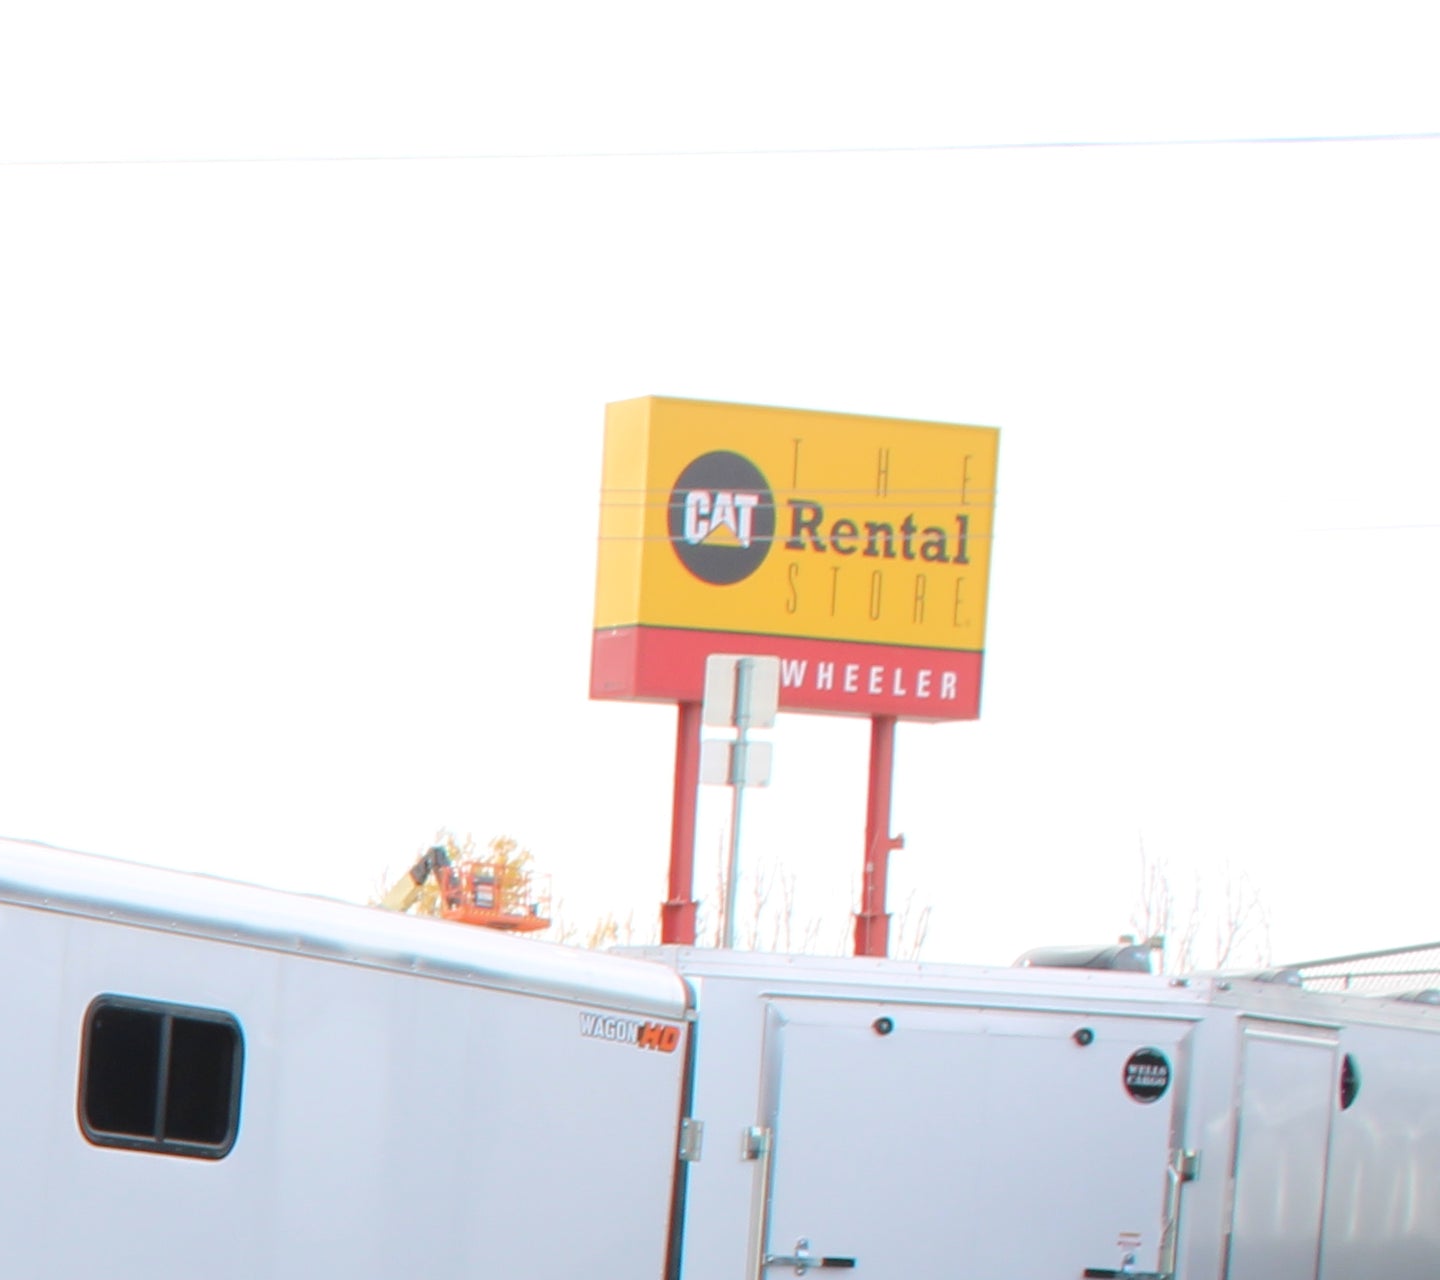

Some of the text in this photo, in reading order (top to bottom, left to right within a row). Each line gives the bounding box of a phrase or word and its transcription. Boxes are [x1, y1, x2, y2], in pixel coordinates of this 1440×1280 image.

[791, 438, 973, 506] THE
[683, 488, 760, 550] CAT
[784, 497, 971, 565] Rental
[785, 562, 967, 628] STORE
[781, 657, 958, 701] WHEELER
[580, 1011, 639, 1045] WAGON
